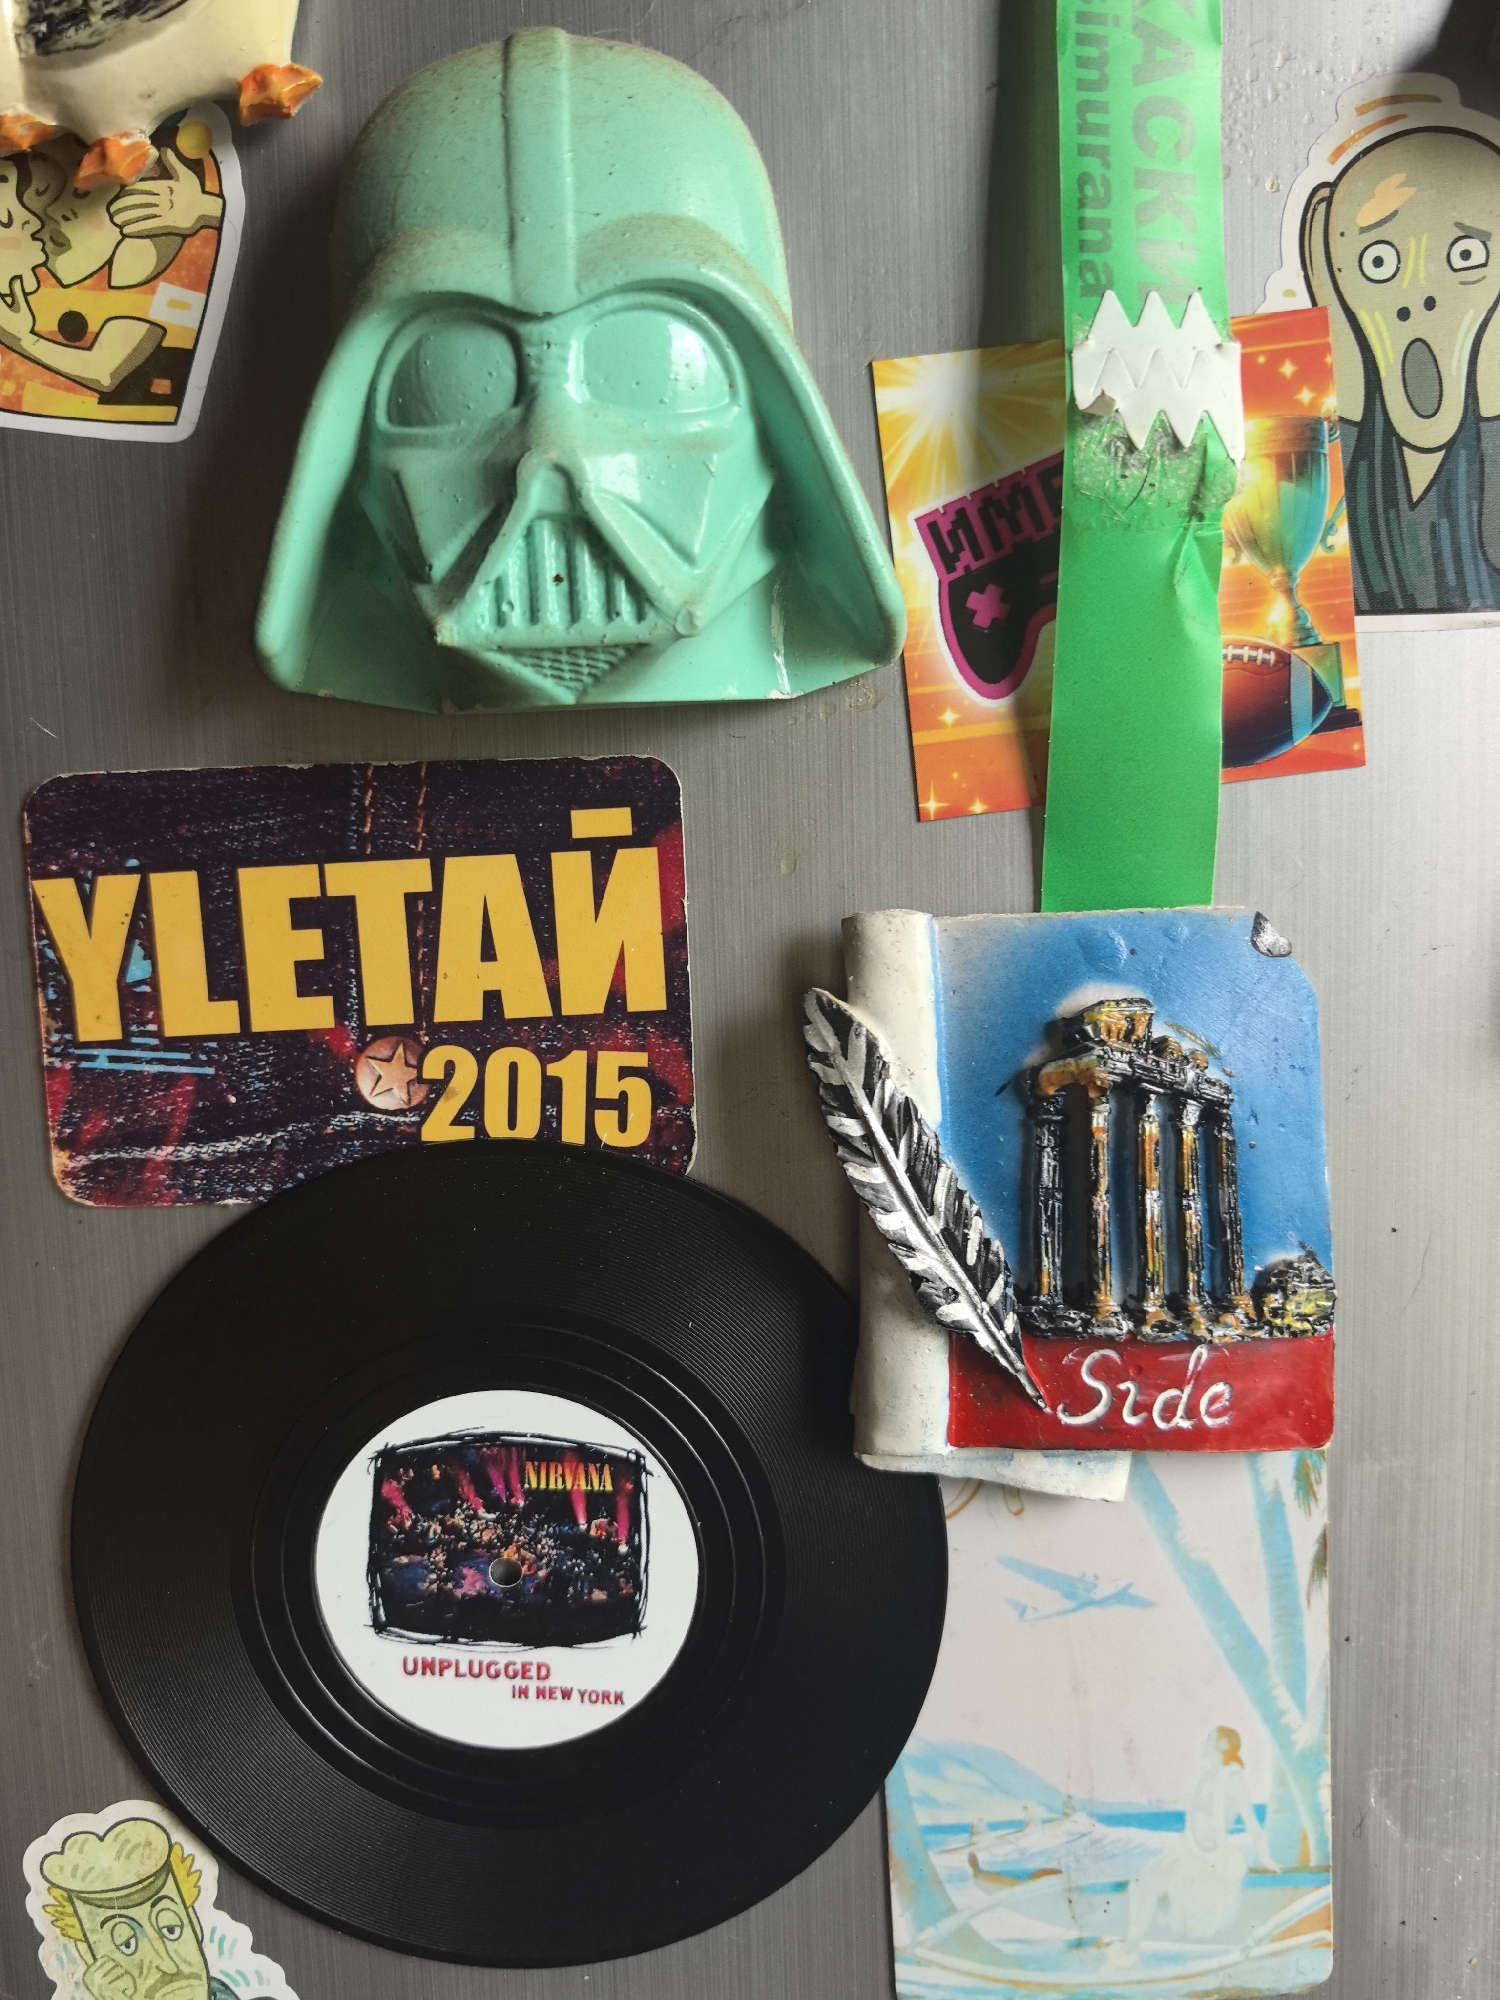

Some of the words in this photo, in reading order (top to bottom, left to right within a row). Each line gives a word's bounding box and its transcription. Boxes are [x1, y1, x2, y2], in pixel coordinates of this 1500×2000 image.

[1075, 0, 1120, 298] imurana
[1131, 0, 1198, 306] АСКИ
[420, 1045, 652, 1148] 2015
[1056, 1343, 1235, 1429] Side
[524, 1461, 614, 1492] NIRVANA
[402, 1656, 551, 1681] UNPLUGGED
[511, 1684, 530, 1700] IN
[536, 1685, 573, 1701] NEW
[577, 1688, 625, 1706] YORK
